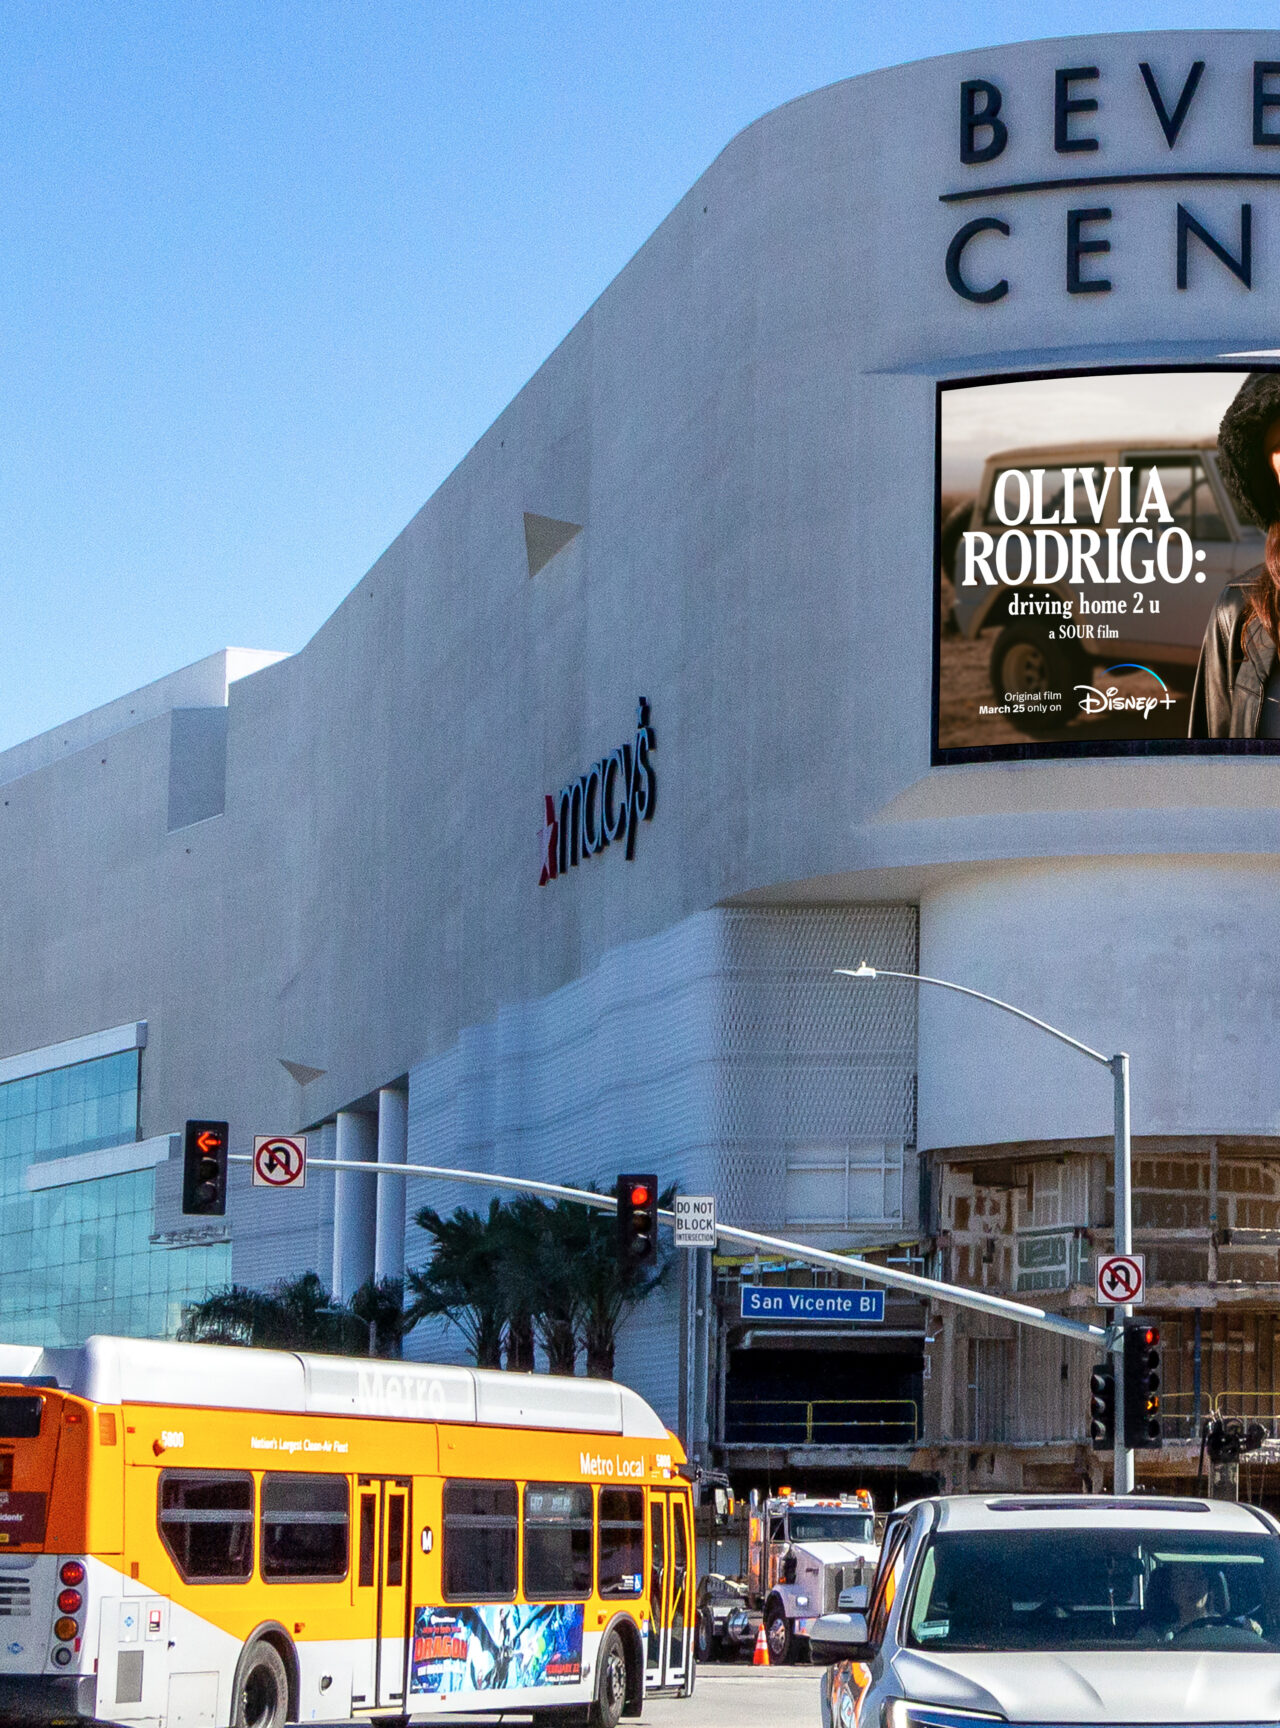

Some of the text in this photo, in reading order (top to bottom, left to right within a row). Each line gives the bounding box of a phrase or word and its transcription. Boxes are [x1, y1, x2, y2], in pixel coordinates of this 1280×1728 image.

[994, 465, 1175, 527] OLIVIA
[961, 526, 1207, 586] RODRIGO:
[1008, 592, 1160, 619] driving home 2 u
[1048, 624, 1119, 639] a SOUR film
[1004, 691, 1062, 704] Original film
[979, 703, 1062, 715] March 25 only on
[676, 1201, 713, 1214] DO NOT
[676, 1218, 713, 1230] BLOCK
[676, 1233, 714, 1242] INTERSECTION
[751, 1293, 876, 1312] San Vicente Bl
[358, 1366, 445, 1418] Metro
[579, 1452, 645, 1478] Metro Local
[422, 1530, 433, 1551] M
[413, 1635, 468, 1664] DRAGON
